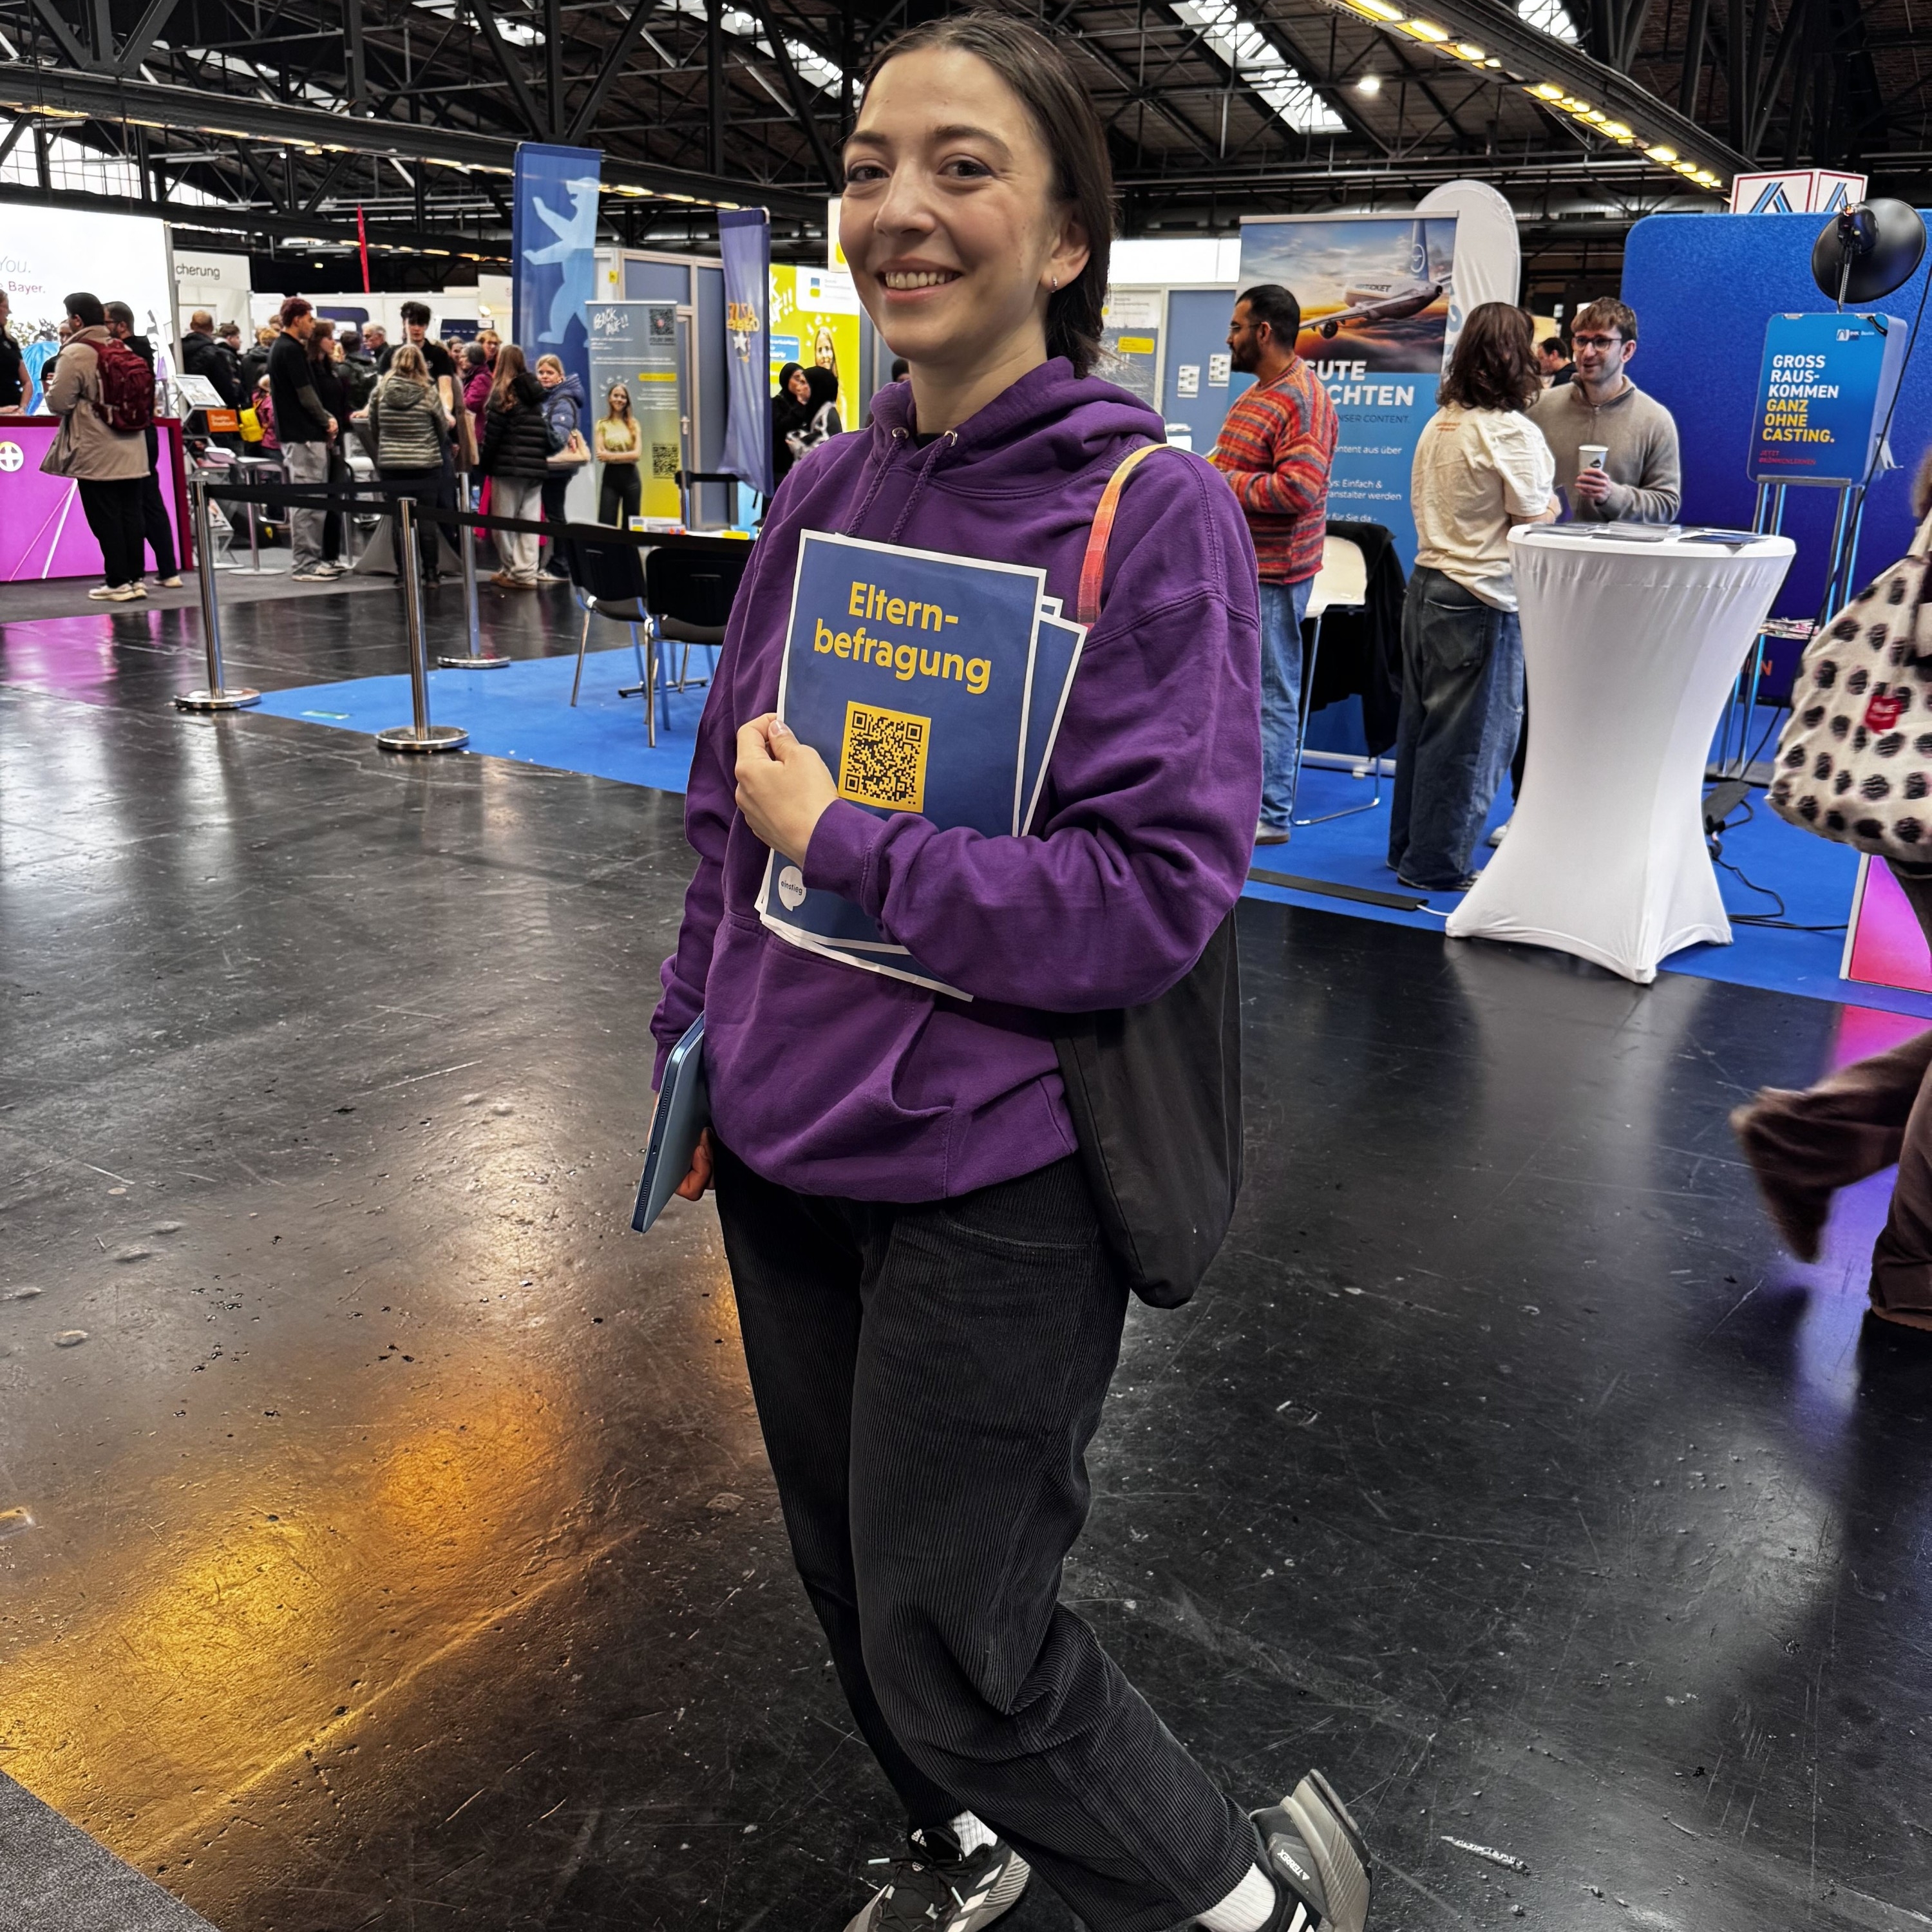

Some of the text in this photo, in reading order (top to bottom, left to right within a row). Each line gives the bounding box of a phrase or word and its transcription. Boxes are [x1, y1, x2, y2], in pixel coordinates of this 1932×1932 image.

[176, 263, 220, 280] cherung
[8, 281, 46, 295] Bayer.
[1773, 355, 1826, 368] GROSS
[1770, 370, 1820, 383] RAUS-
[1768, 384, 1839, 399] KOMMEN
[1766, 399, 1808, 412] GANZ
[1363, 414, 1410, 424] CONTENT.
[1764, 413, 1808, 427] OHNE
[1762, 428, 1835, 443] CASTING.
[1381, 446, 1402, 455] über
[1342, 479, 1374, 489] Einfach
[1376, 480, 1383, 489] &
[1368, 492, 1402, 500] werden
[1346, 513, 1359, 522] Sie
[1360, 514, 1372, 522] da
[848, 581, 959, 632] Eltern-
[813, 618, 992, 695] befragung
[781, 880, 803, 896] einstieg
[1277, 1849, 1303, 1877] TERREX
